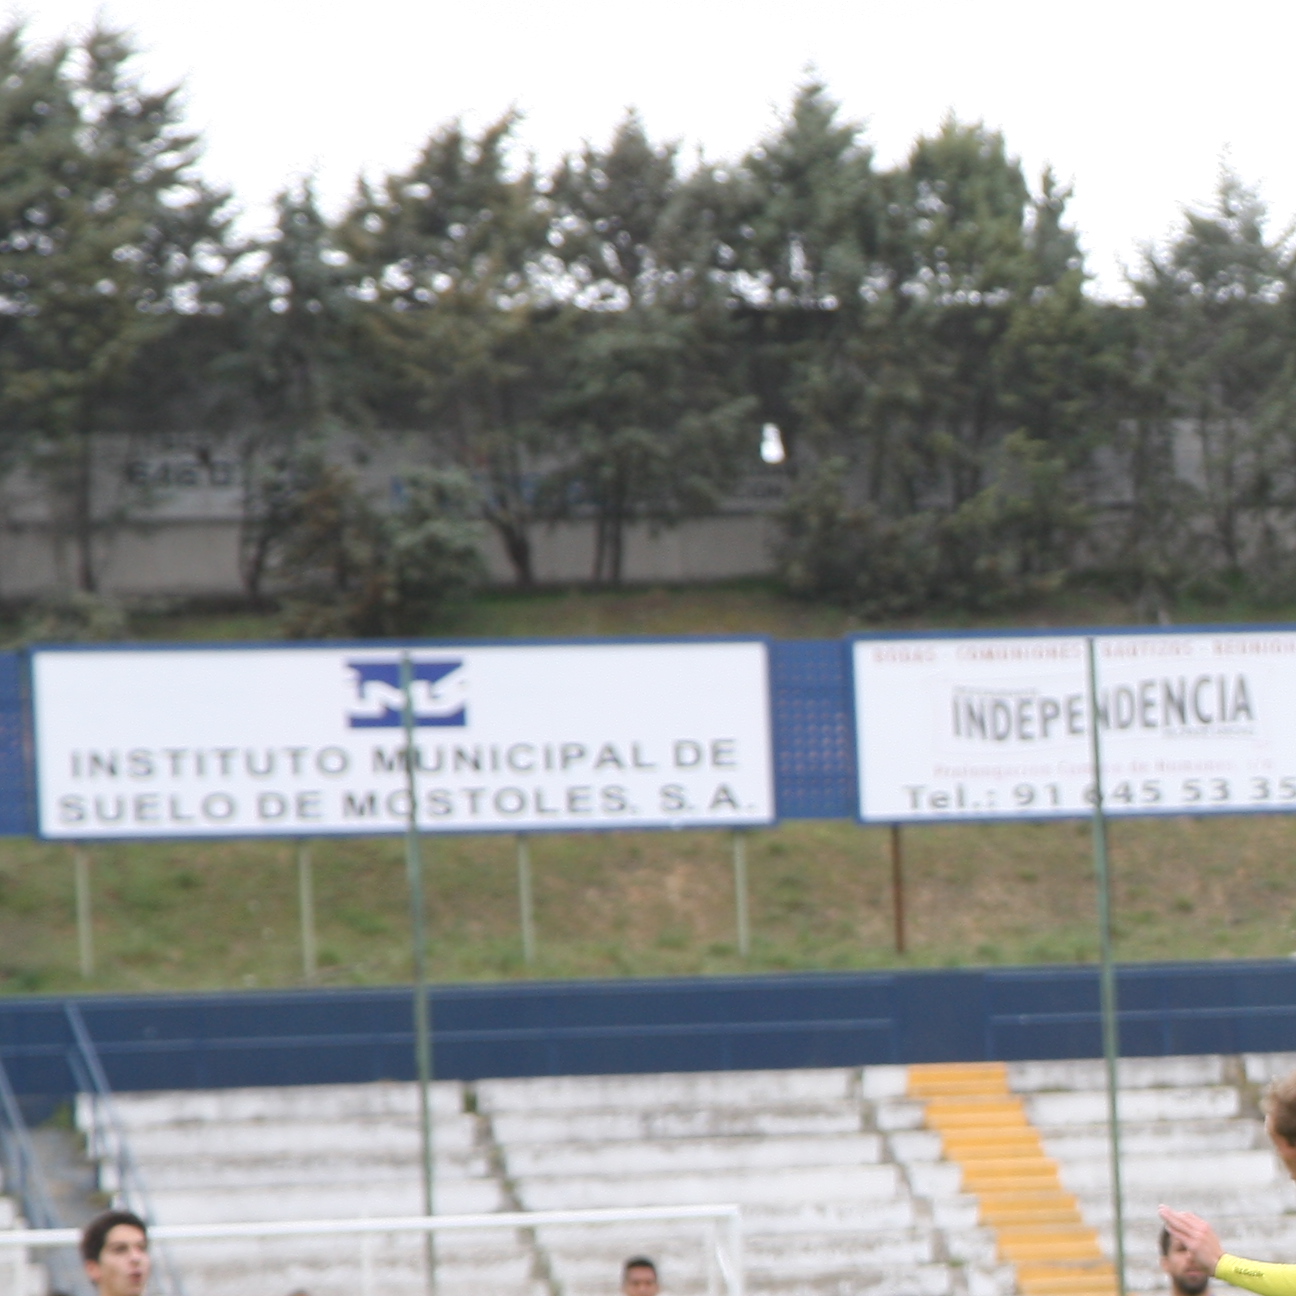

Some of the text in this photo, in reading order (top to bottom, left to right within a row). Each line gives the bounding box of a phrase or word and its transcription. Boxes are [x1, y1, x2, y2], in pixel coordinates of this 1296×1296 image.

[952, 674, 1255, 741] INDEPENDENCIA
[70, 738, 737, 779] INSTITUTO MUNICIPAL DE
[58, 791, 236, 824] SUELO
[257, 790, 322, 820] DE
[903, 784, 996, 810] Tel.:
[1014, 782, 1060, 807] 91
[1083, 779, 1161, 806] 645
[1181, 777, 1229, 802] 53
